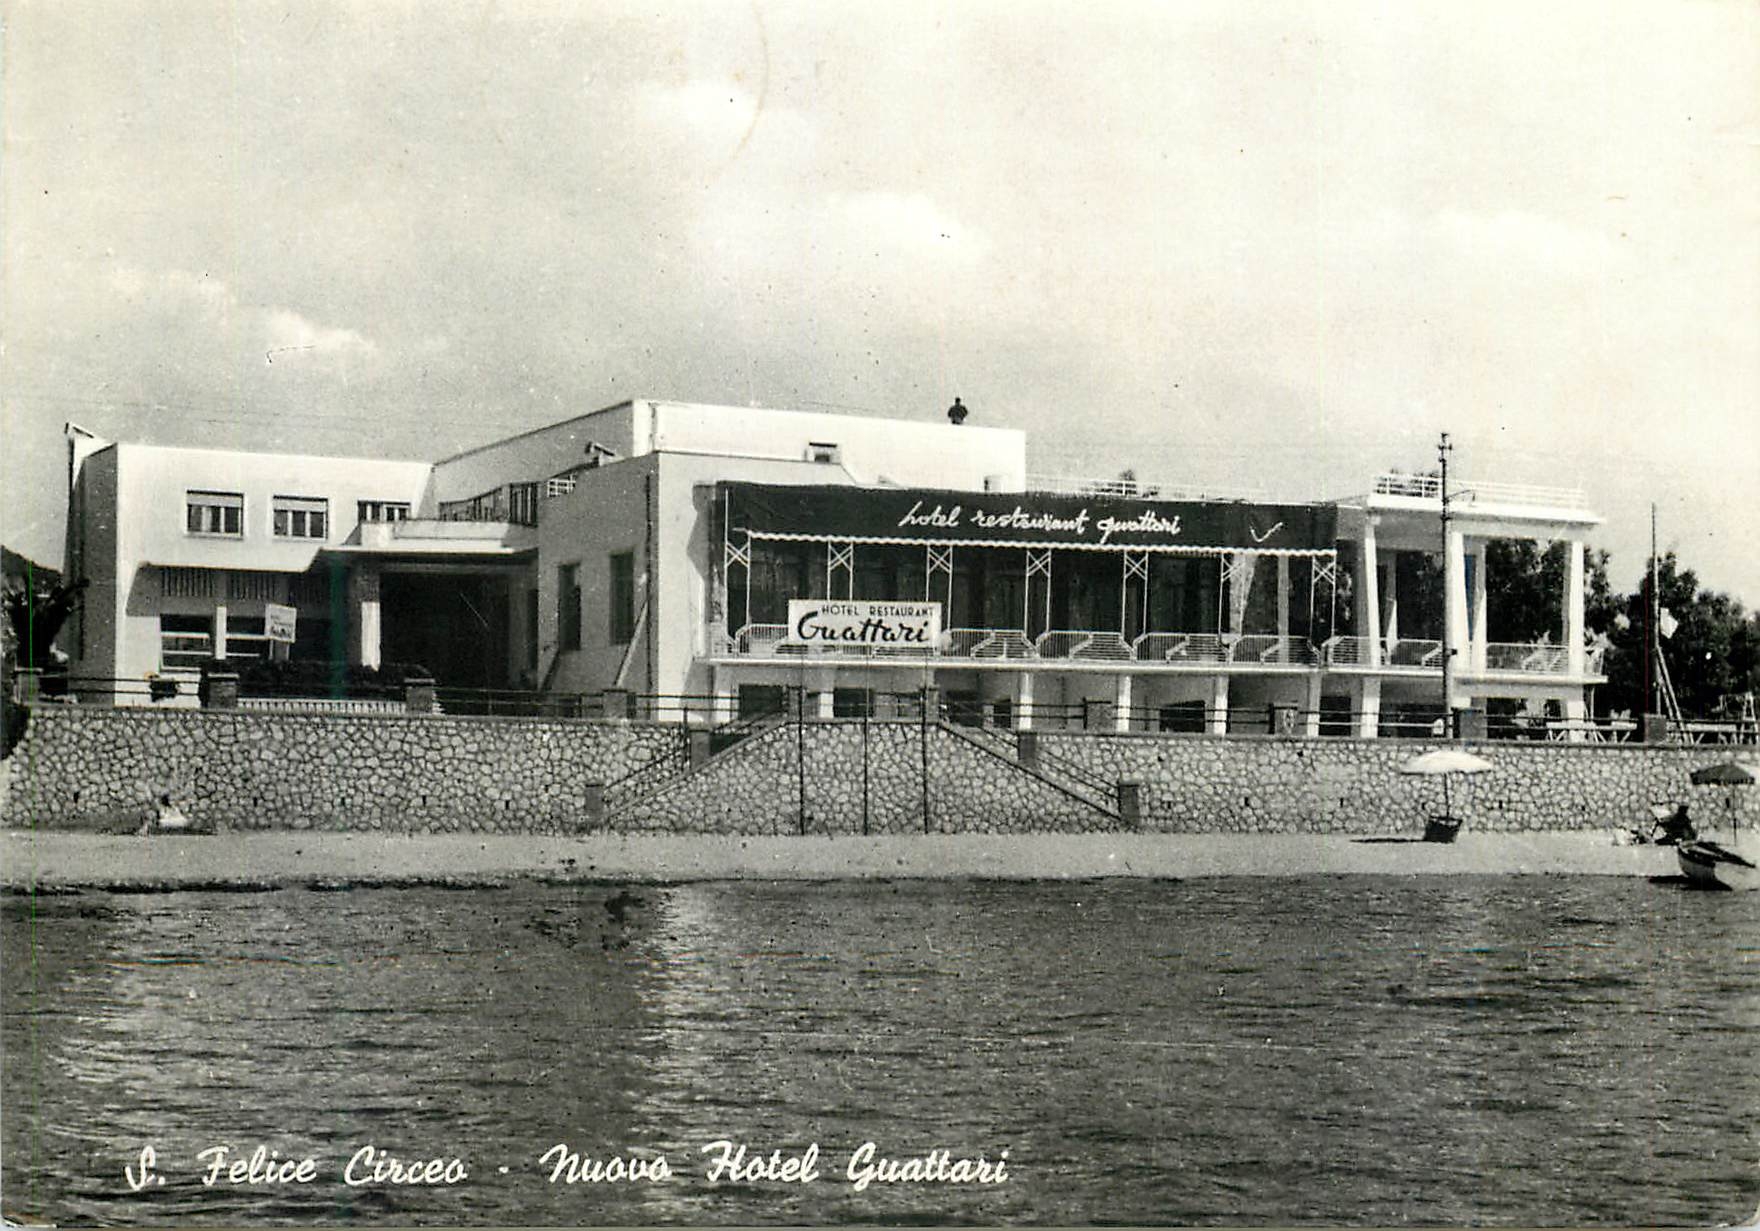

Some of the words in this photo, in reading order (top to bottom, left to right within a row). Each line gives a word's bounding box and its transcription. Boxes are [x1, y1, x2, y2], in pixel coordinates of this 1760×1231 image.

[898, 501, 961, 527] hotel
[822, 605, 859, 616] HOTEL
[870, 605, 934, 617] RESTAURANT
[797, 611, 930, 642] Guattari
